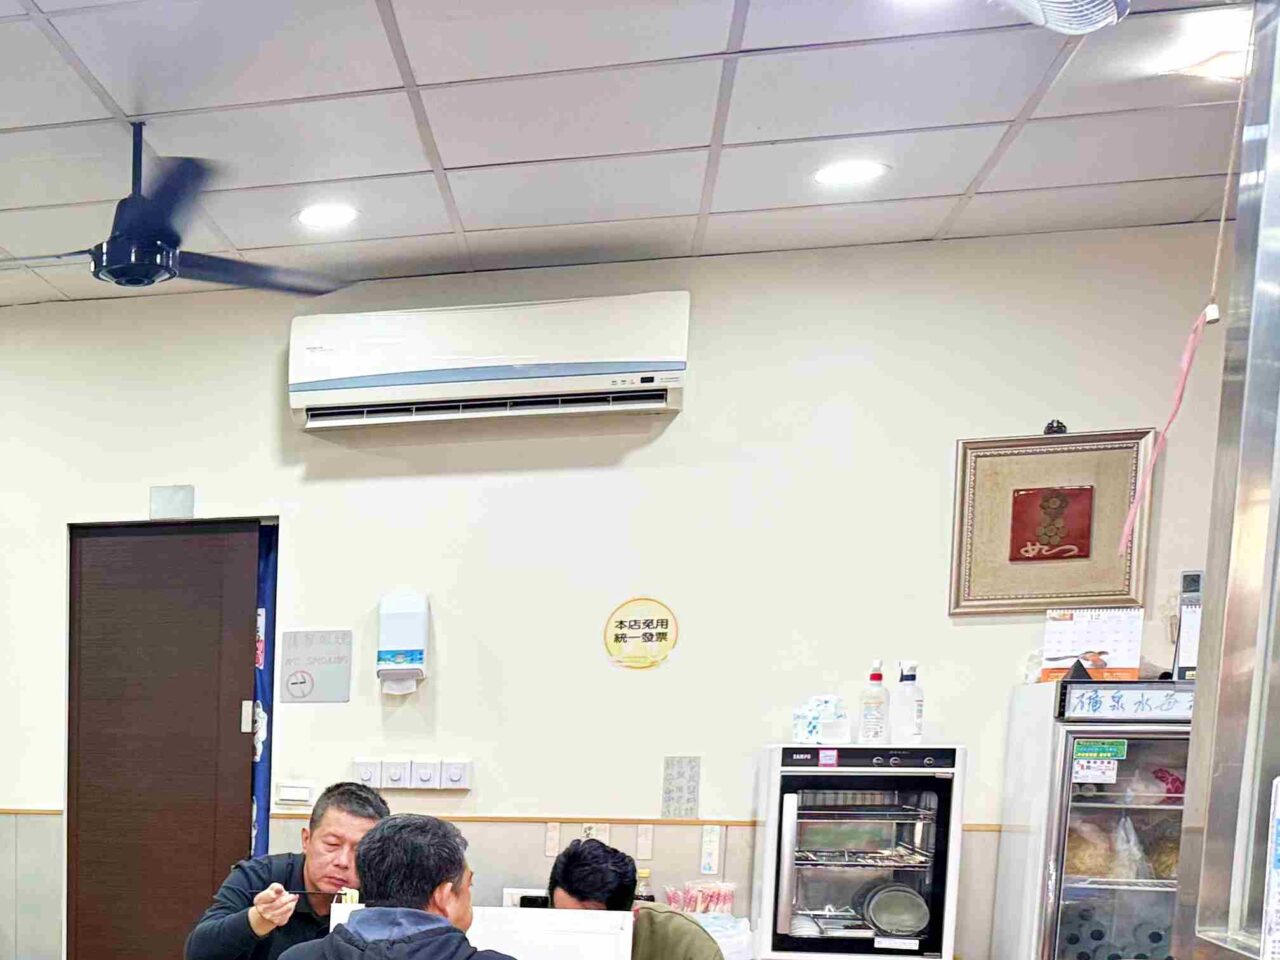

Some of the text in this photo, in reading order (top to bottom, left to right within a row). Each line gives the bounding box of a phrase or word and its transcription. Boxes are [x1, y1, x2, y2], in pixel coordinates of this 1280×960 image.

[614, 618, 669, 630] 本店免用
[614, 631, 669, 643] 統一發票
